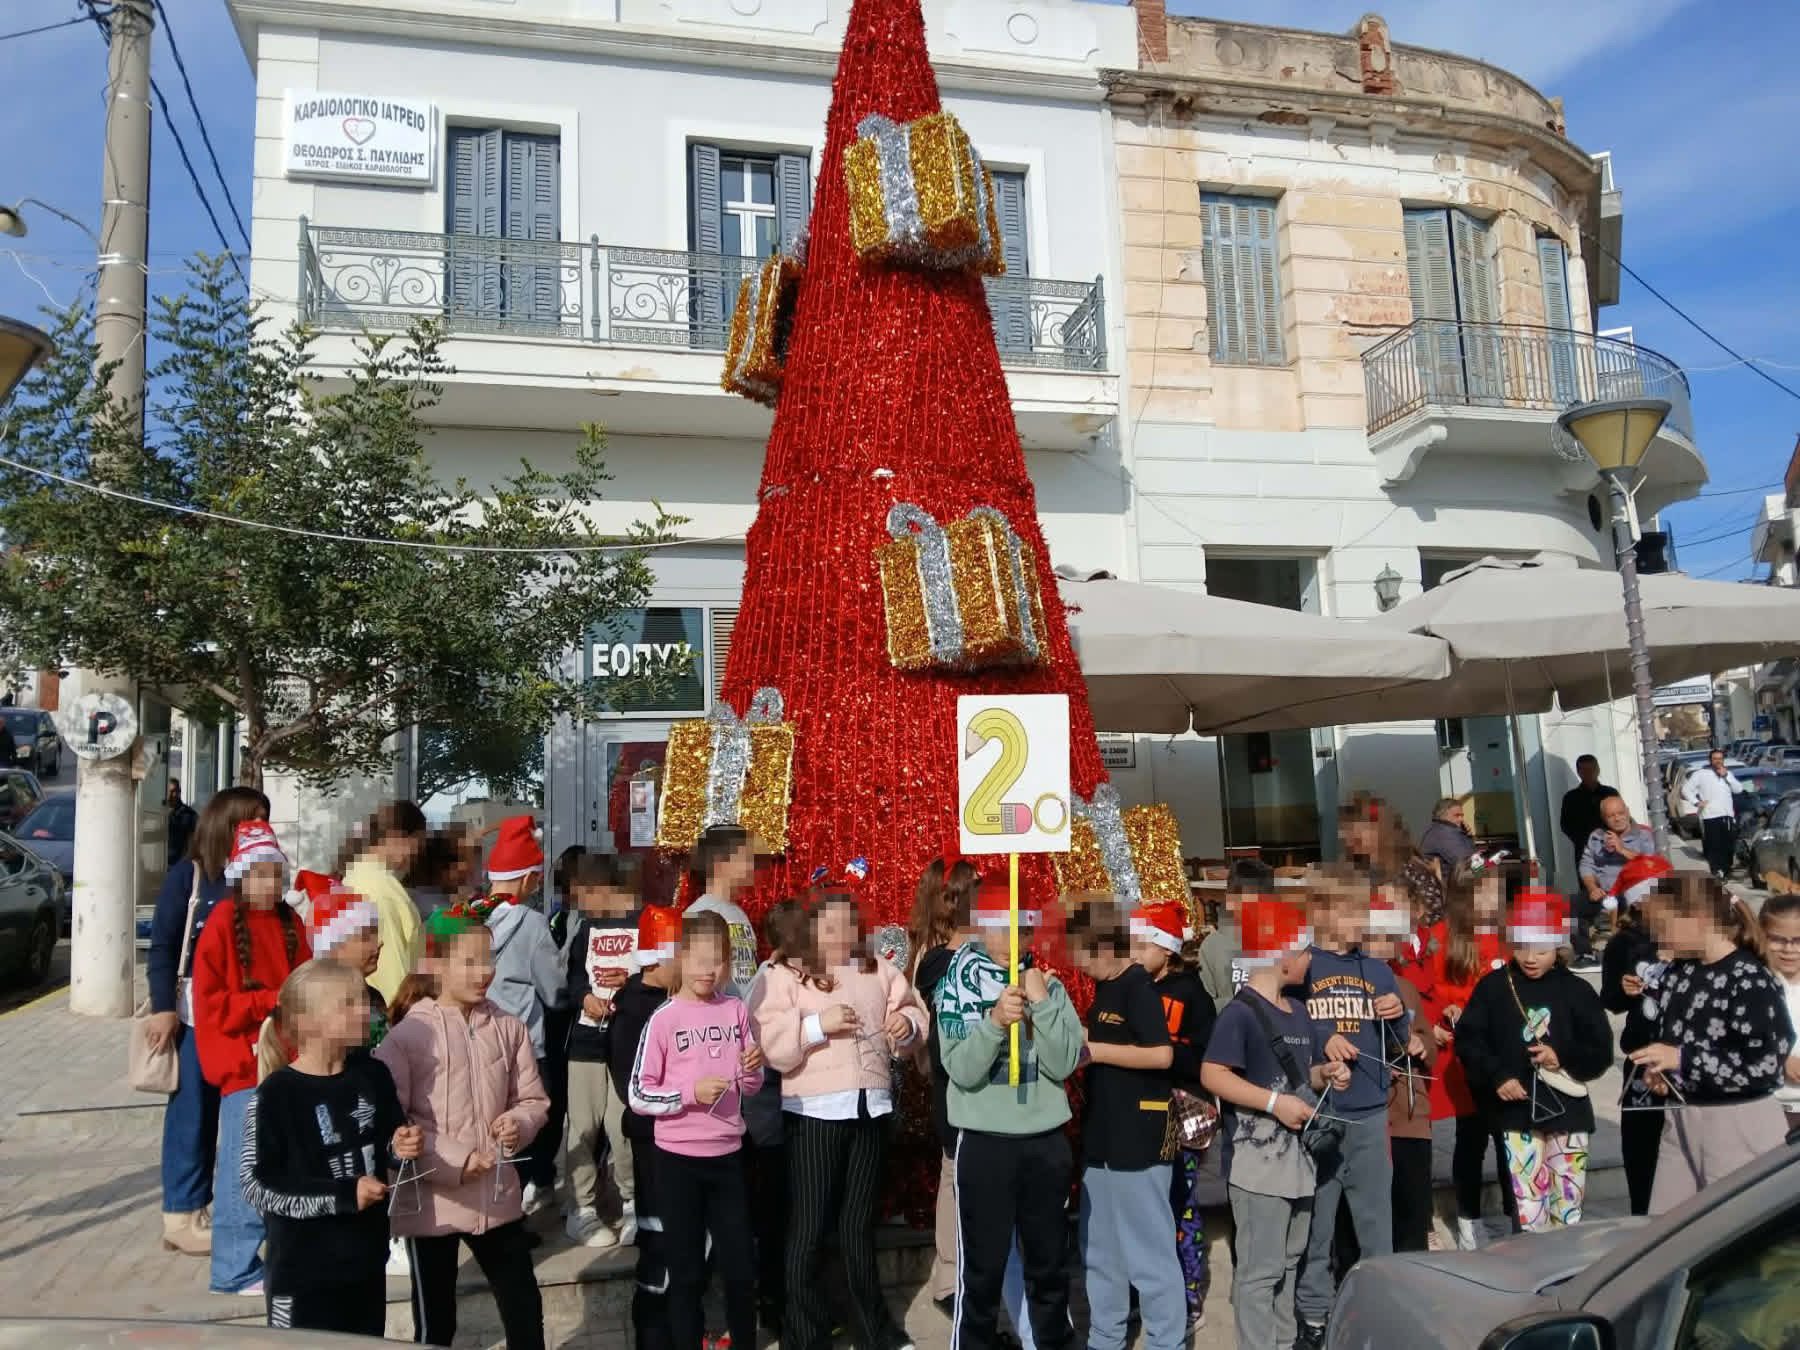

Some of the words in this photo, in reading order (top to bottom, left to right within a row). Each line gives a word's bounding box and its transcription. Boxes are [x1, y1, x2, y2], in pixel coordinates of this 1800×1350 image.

[294, 98, 378, 122] ΚΑΡΔΙΟΛΟΓΙΚΟ
[382, 103, 425, 132] ΙΑΤΡΕΙΟ
[293, 144, 354, 161] ΘΕΟΔΩΡΟΣ
[357, 148, 367, 161] Σ.
[370, 149, 424, 165] ΠΑΥΛΙΔΗΣ
[88, 711, 117, 744] P
[596, 938, 628, 951] NEW
[1312, 975, 1341, 992] ABSENT
[1306, 996, 1378, 1020] ORIGINA
